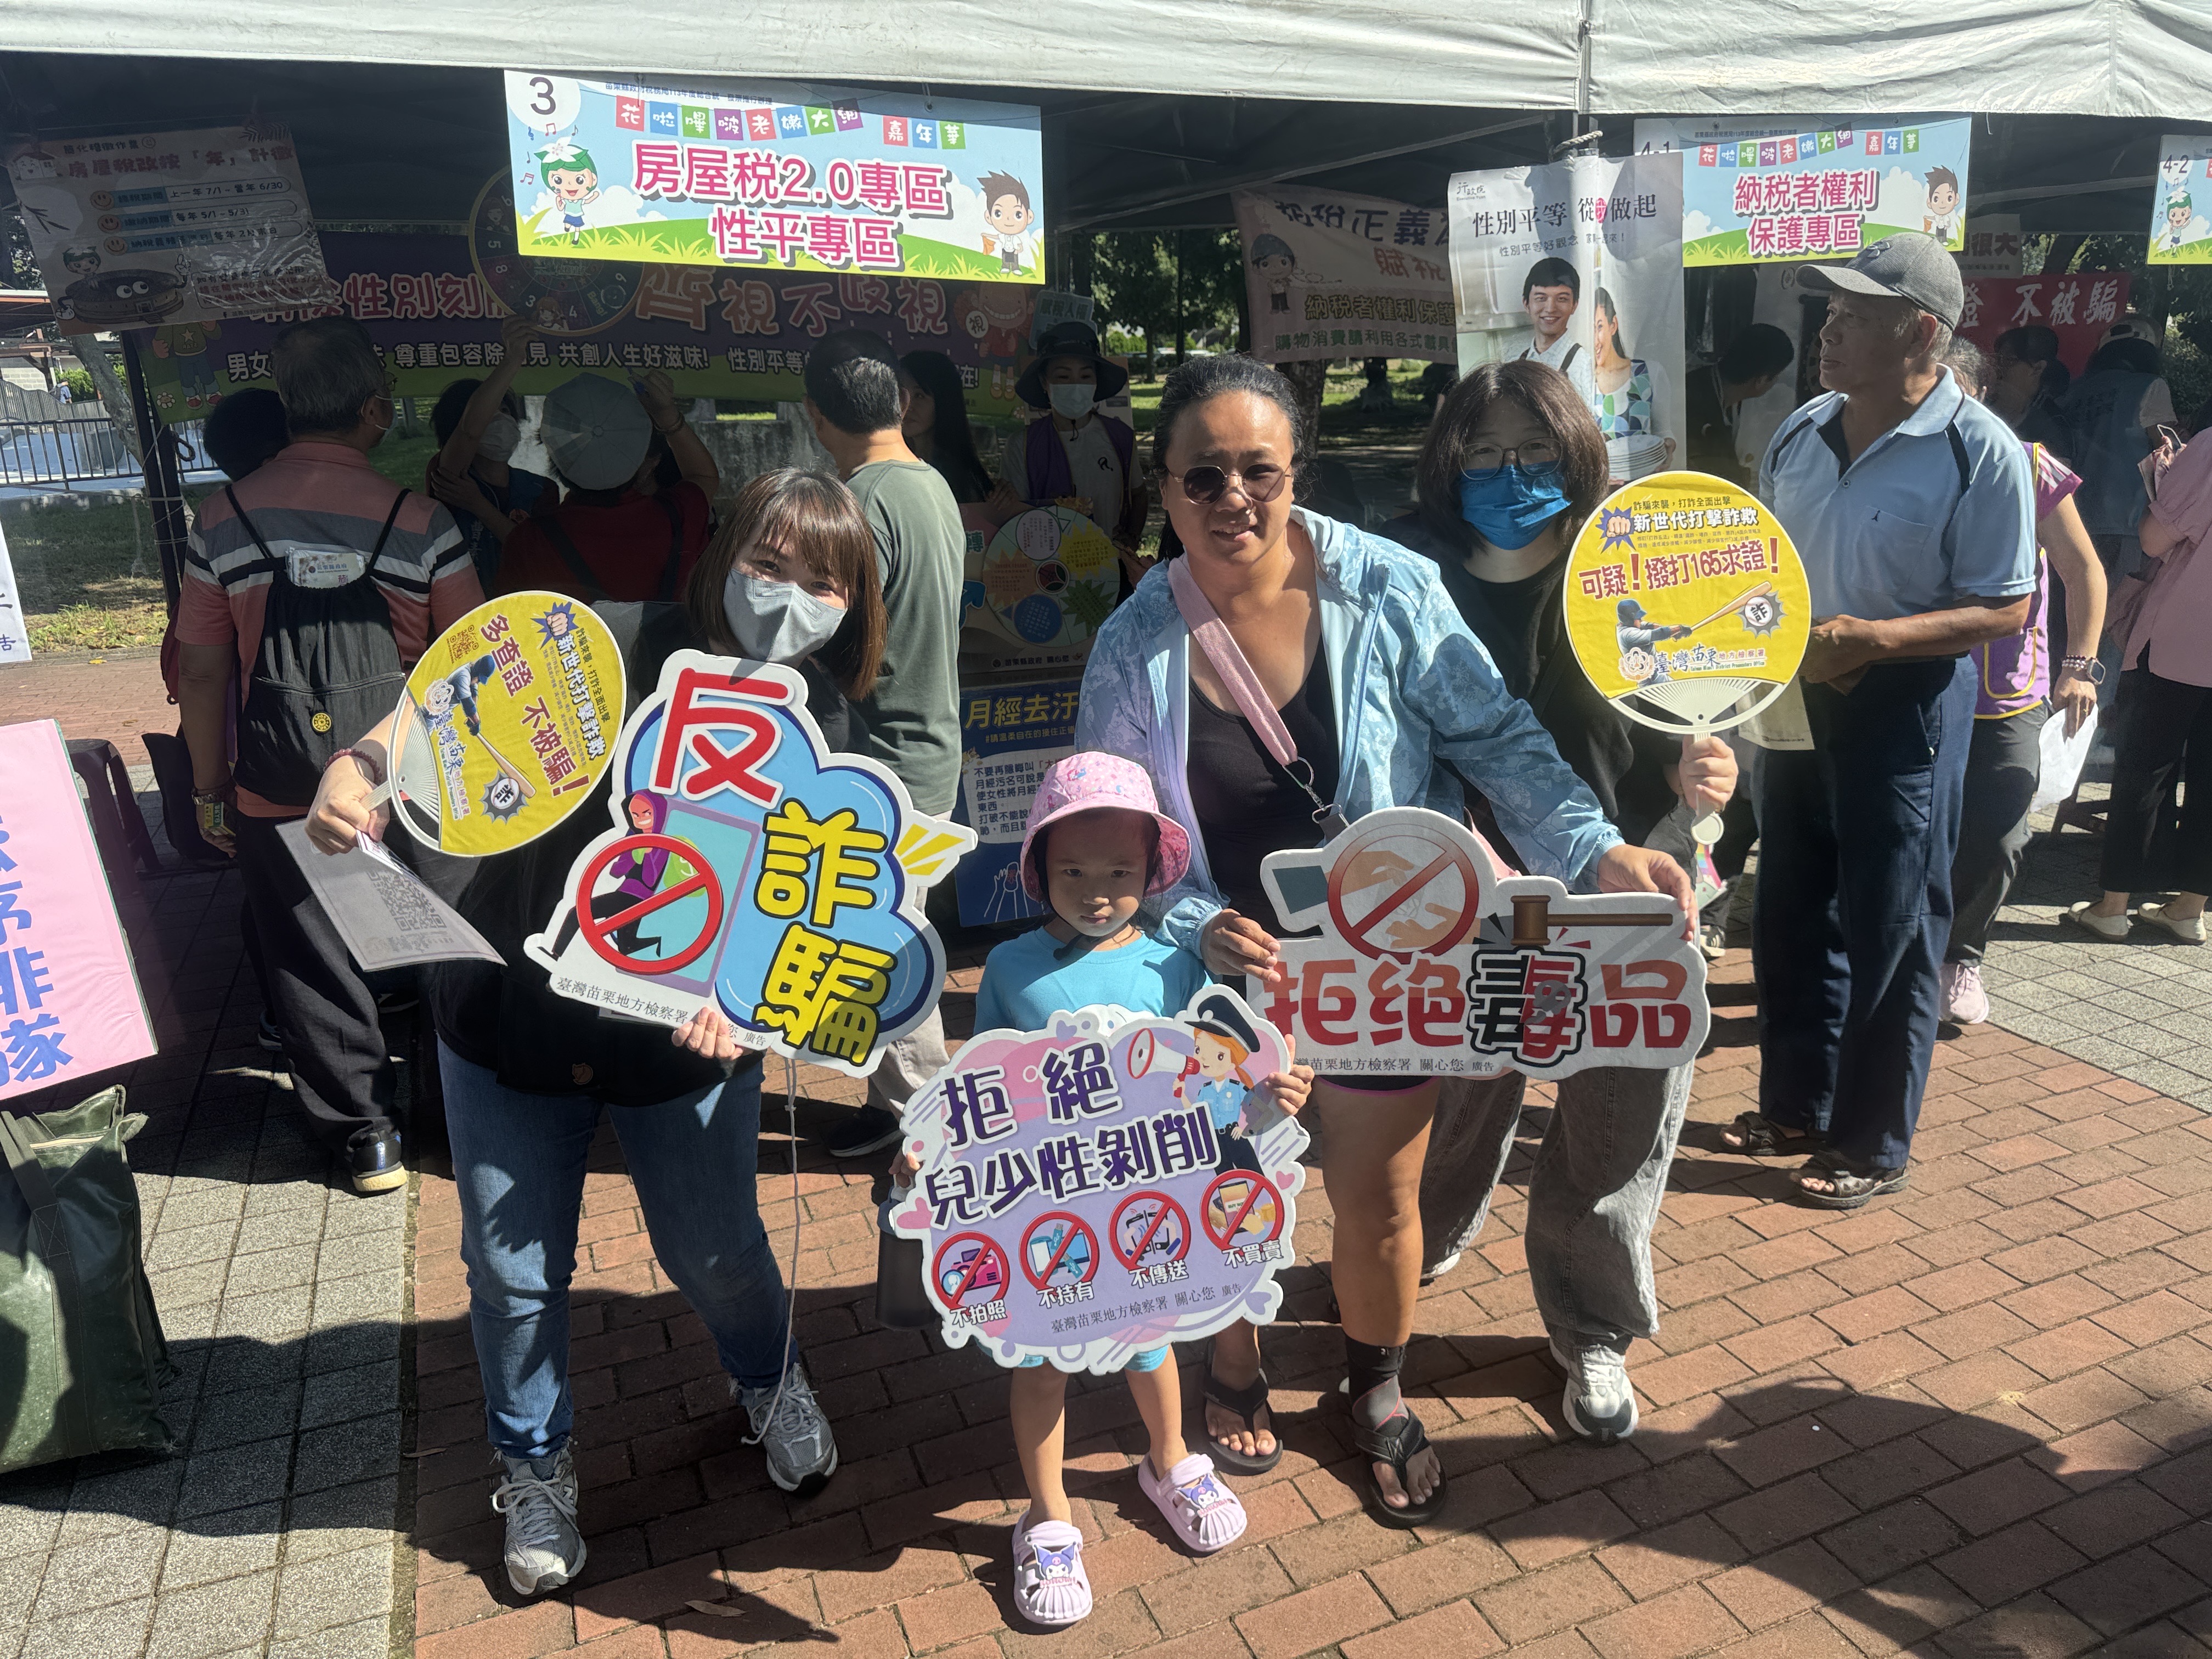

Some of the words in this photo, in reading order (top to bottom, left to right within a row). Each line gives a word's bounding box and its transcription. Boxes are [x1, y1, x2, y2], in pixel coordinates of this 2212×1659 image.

[530, 77, 556, 115] 3
[888, 120, 961, 145] 嘉年華
[1869, 133, 1917, 152] 嘉年華
[2163, 154, 2189, 173] 4-2
[259, 182, 283, 190] 6/30
[1472, 201, 1568, 238] 性別平等
[1748, 213, 1860, 252] 保護專區
[711, 207, 896, 264] 性平專區
[1499, 234, 1579, 257] 性別平等好觀念
[495, 264, 508, 274] 8
[525, 295, 536, 308] 3
[569, 304, 578, 318] 4
[2011, 278, 2119, 328] 不被騙
[968, 315, 986, 334] 視
[394, 341, 549, 368] 尊重包容除見
[1633, 506, 1759, 533] 新世代打擊詐欺
[1750, 603, 1768, 622] 詐
[479, 613, 538, 697] 多查證
[557, 633, 607, 761] 新世代打擊詐欺
[653, 667, 789, 804] 反
[495, 783, 516, 804] 詐
[976, 785, 1040, 802] 使女性將月經
[755, 798, 897, 1066] 詐騙
[557, 977, 689, 1025] 臺灣苗栗地方檢察署
[743, 1031, 767, 1046] 廣告
[1419, 1058, 1464, 1071] 關心您
[1471, 1061, 1494, 1071] 廣告
[926, 1105, 1219, 1226] 兒少性剝削
[1222, 1238, 1284, 1267] 不買賣
[1128, 1260, 1189, 1288] 不傳送
[1036, 1280, 1094, 1308] 不持有
[949, 1300, 1008, 1328] 不拍照
[1051, 1295, 1168, 1334] 臺灣苗栗地方檢察署
[1175, 1286, 1215, 1307] 關心您
[1221, 1283, 1242, 1297] 廣告
